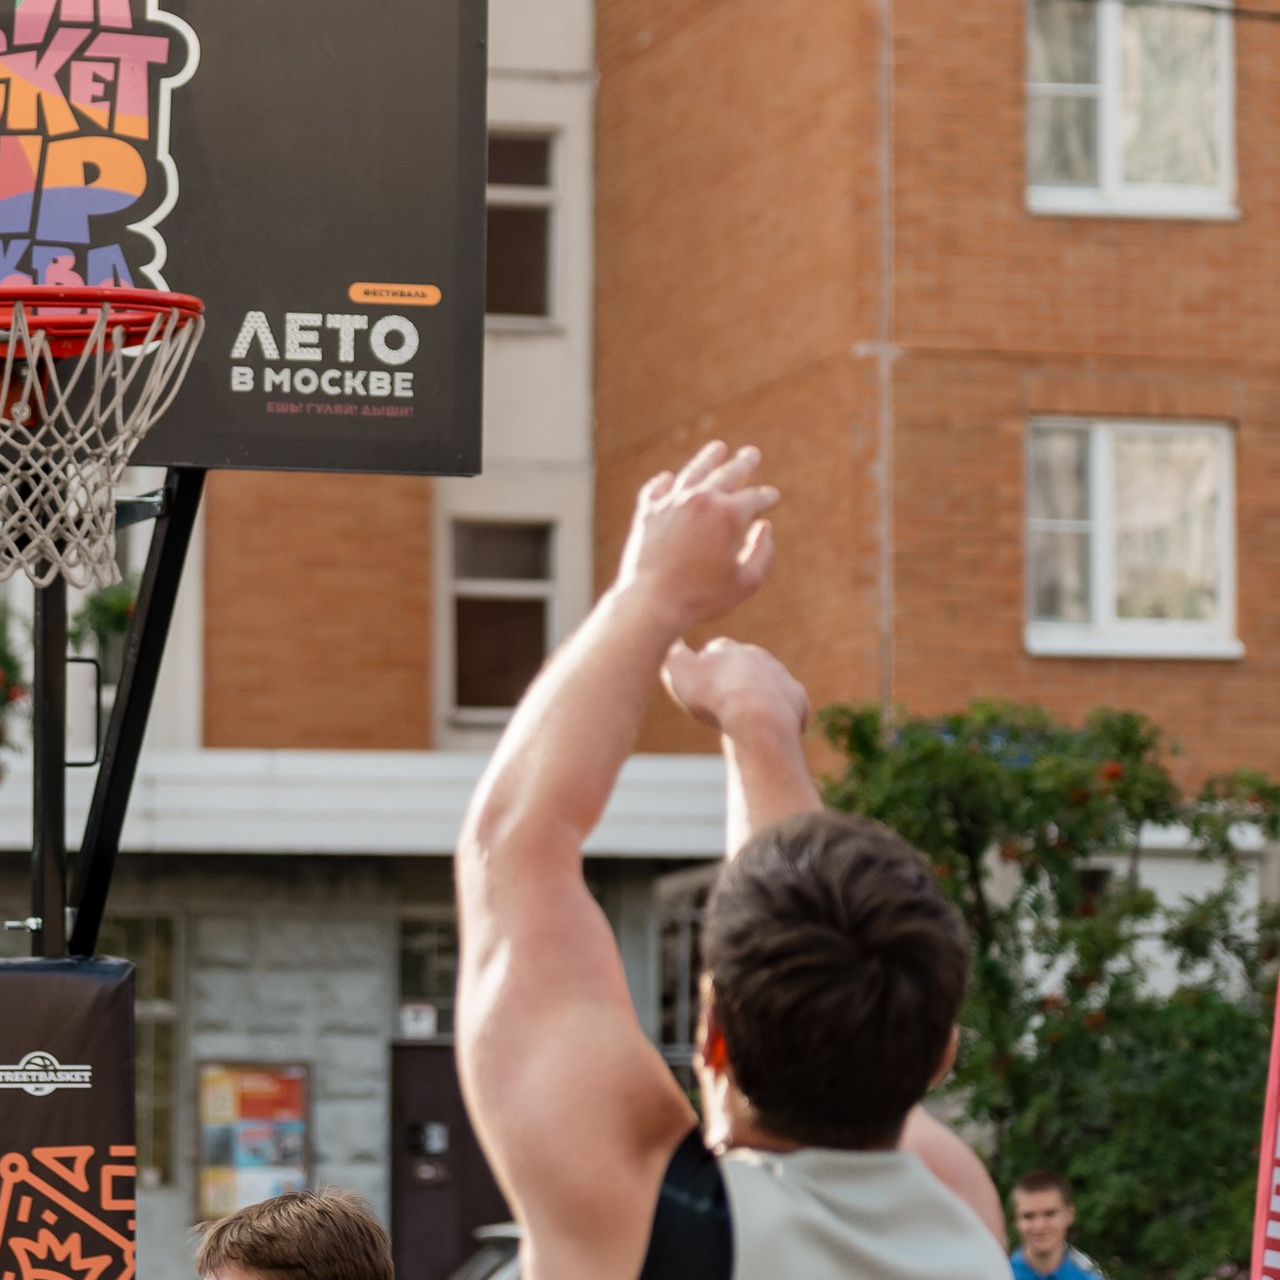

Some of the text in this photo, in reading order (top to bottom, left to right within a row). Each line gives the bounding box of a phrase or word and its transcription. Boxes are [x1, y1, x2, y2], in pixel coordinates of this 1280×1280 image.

[363, 288, 428, 299] ФЕСТИВАЛЬ
[230, 310, 420, 366] ЛЕТО
[231, 365, 414, 397] В МОСКВЕ
